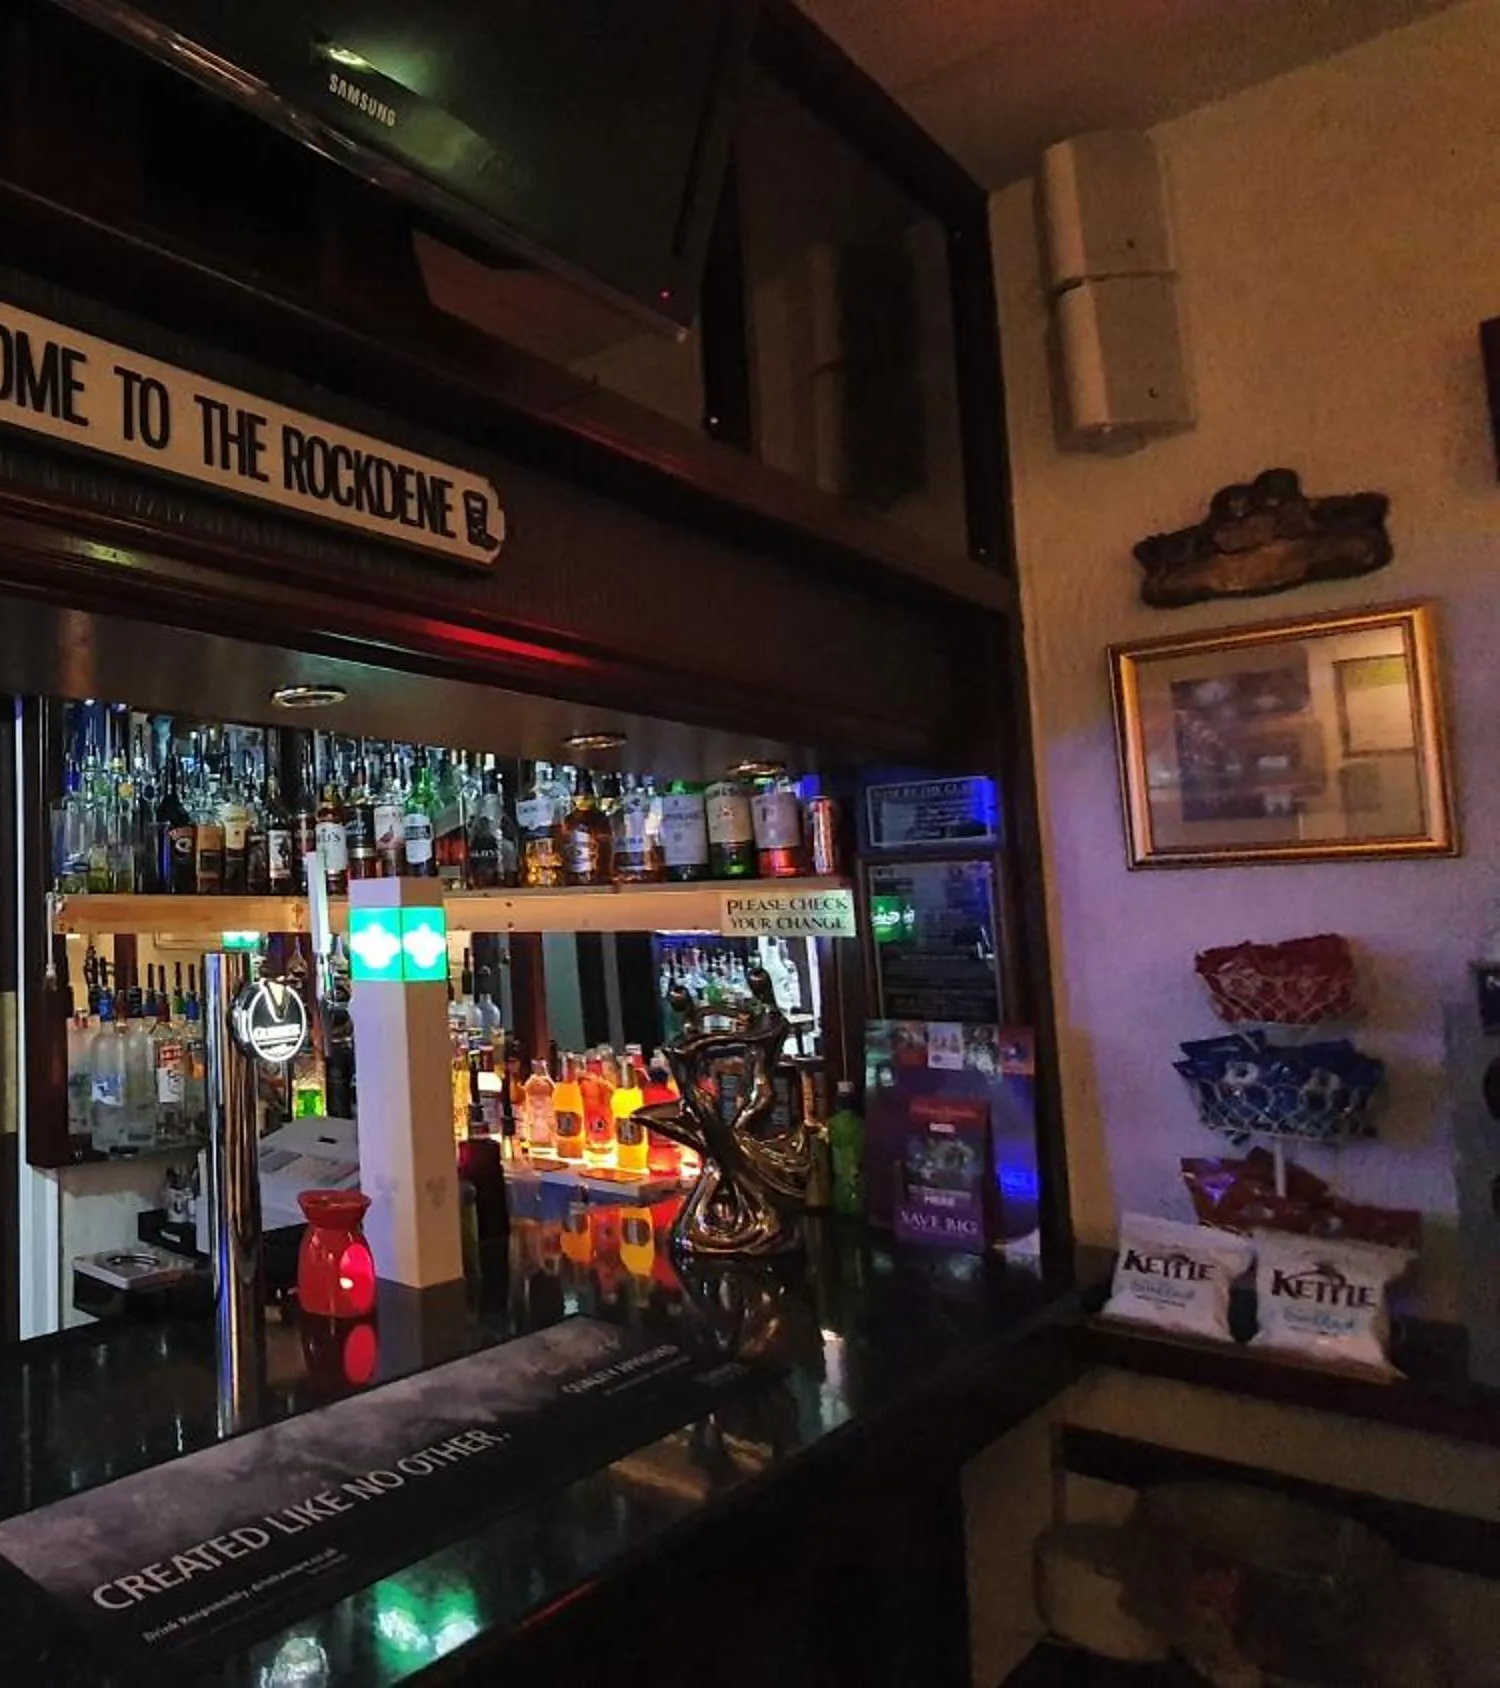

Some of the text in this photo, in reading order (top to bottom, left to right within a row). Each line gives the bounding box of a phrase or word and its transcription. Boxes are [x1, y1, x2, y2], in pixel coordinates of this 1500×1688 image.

[328, 73, 397, 127] SAMSUNG
[113, 365, 170, 450] TO
[193, 394, 270, 484] THE
[281, 423, 457, 539] ROCKDENE
[727, 897, 848, 915] PLEASE CHECK
[730, 916, 847, 930] YOUR CHANGE
[1122, 1250, 1216, 1282] KETTLE
[1271, 1264, 1378, 1308] KETTLE
[93, 1526, 270, 1610] CREATED
[265, 1489, 354, 1535] LIKE
[341, 1469, 405, 1501] NO
[397, 1427, 512, 1476] OTHER.
